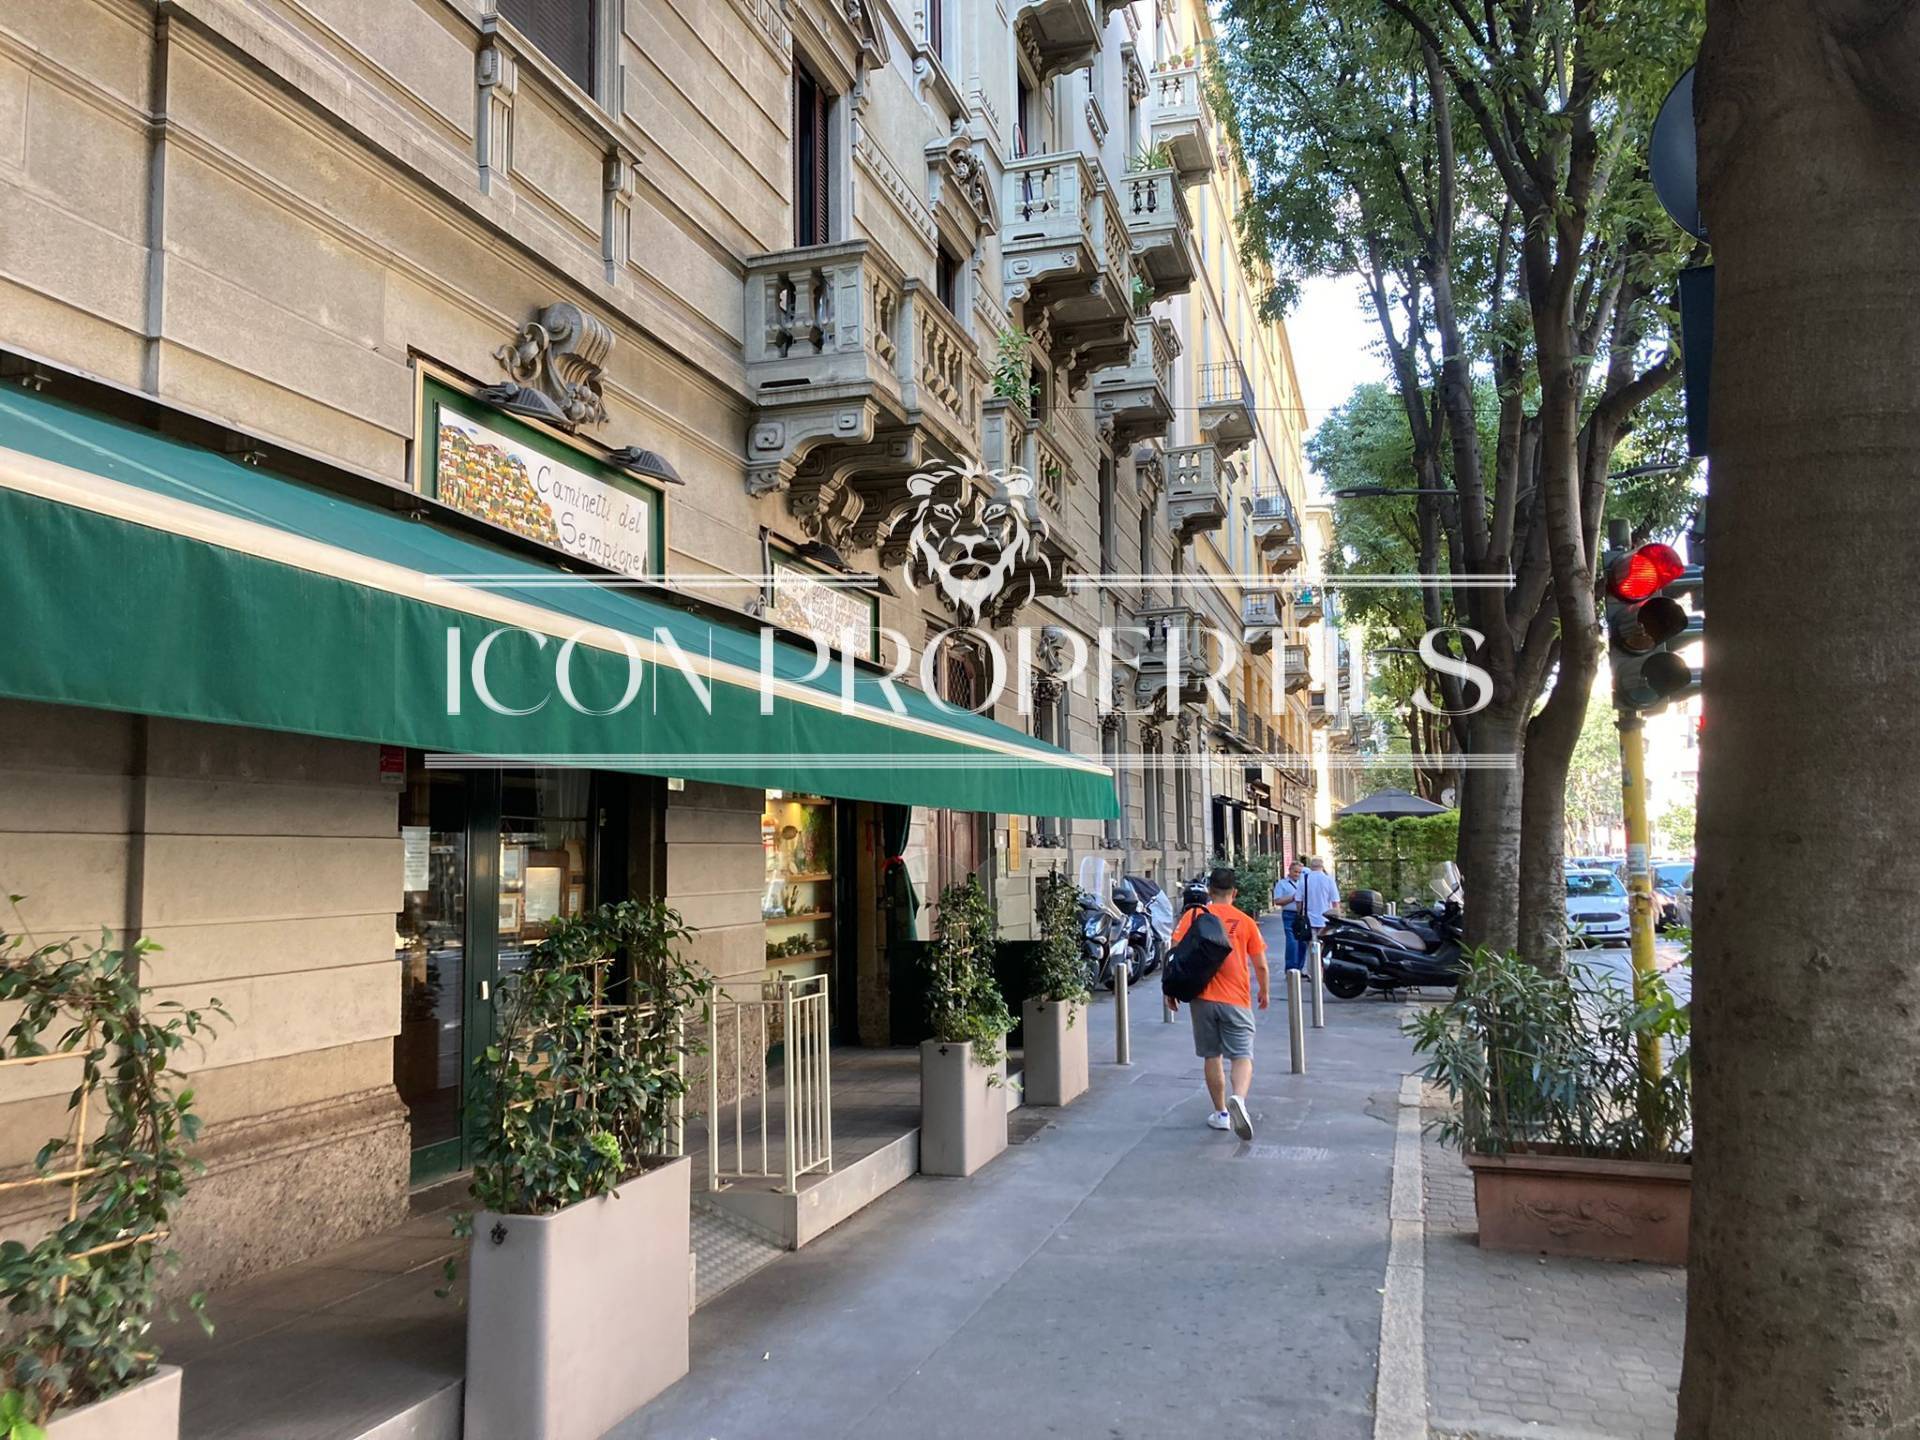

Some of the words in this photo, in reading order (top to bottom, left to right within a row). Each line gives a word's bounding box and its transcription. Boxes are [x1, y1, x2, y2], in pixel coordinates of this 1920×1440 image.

[537, 465, 612, 521] Caminetti
[619, 503, 642, 534] del
[560, 511, 640, 570] Sempione
